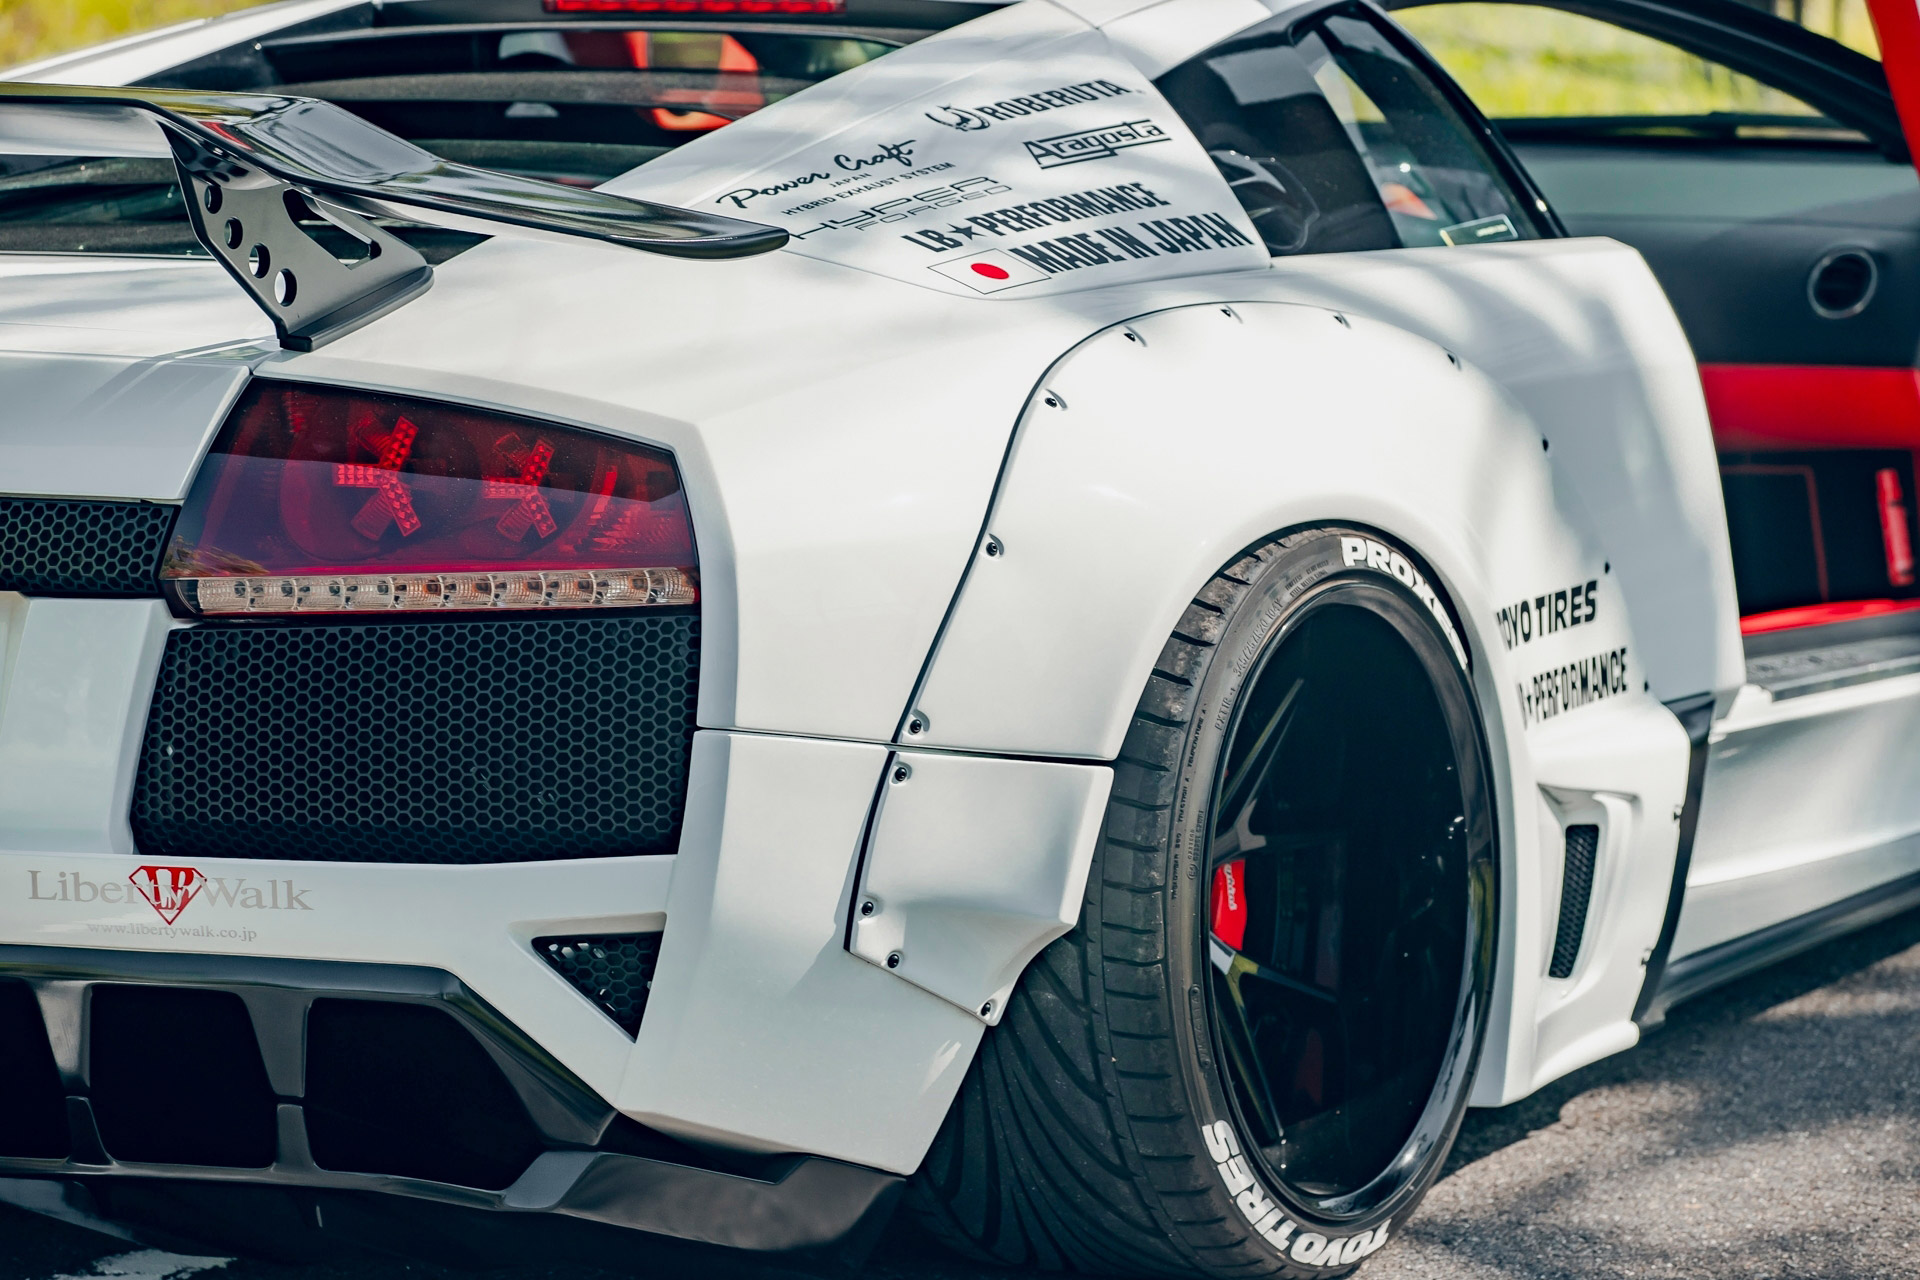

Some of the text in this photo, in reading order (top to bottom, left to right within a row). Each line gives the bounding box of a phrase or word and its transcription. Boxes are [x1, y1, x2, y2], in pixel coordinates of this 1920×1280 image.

[1022, 118, 1172, 170] Aragosta
[715, 139, 917, 209] Power Craft
[781, 161, 956, 216] HYBRID EXHAUST SYSTEM
[829, 172, 871, 188] JAPAN
[964, 182, 1171, 237] PERFORMANCE
[1008, 212, 1255, 274] MADE IN JAPAN
[1535, 579, 1599, 637] TIRES
[27, 869, 189, 915] Liberty
[194, 876, 315, 911] Walk
[87, 922, 258, 942] www.libertywalk.co.jp
[1202, 1119, 1392, 1267] TOYO TIRES
